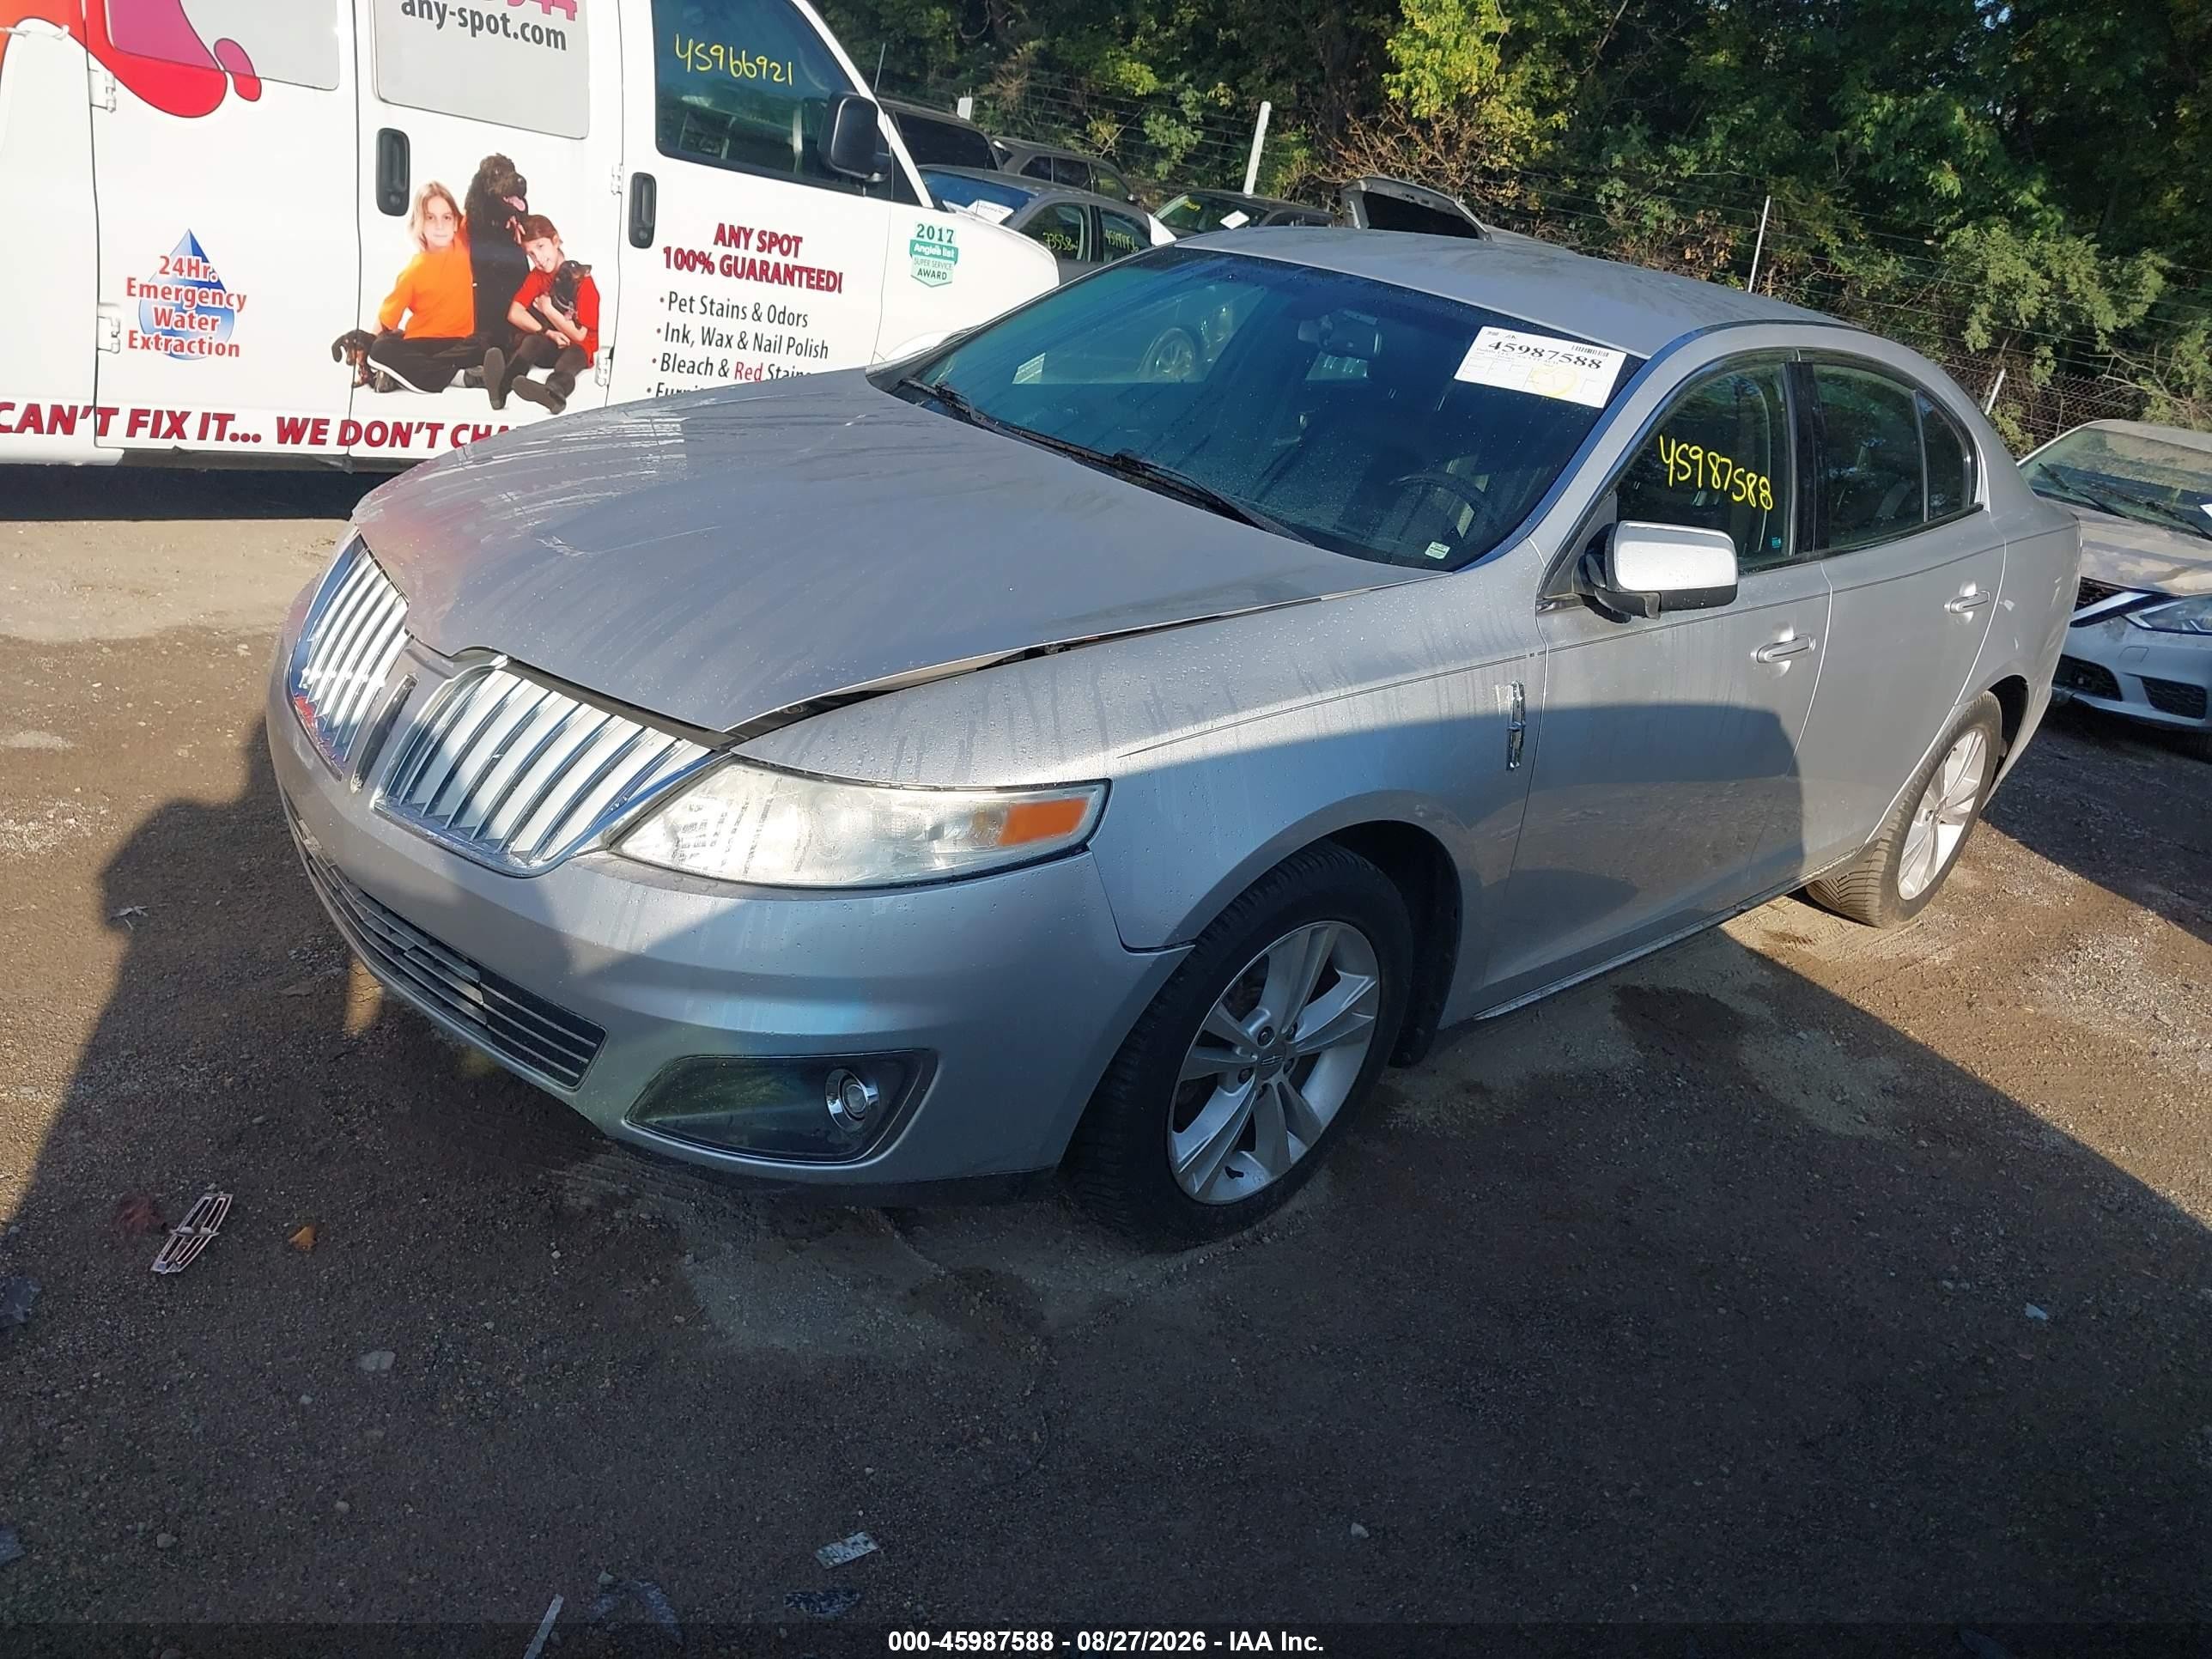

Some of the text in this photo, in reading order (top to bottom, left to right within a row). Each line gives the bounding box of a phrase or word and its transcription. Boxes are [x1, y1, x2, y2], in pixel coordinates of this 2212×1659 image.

[401, 0, 567, 51] any-spot.com
[675, 33, 793, 87] 45966921
[713, 222, 803, 258] ANY SPOT
[916, 223, 954, 244] 2017
[159, 256, 216, 281] 24Hr.
[663, 246, 844, 295] 100% GUARANTEED!
[917, 268, 947, 281] AWARD
[126, 276, 246, 313] Emergency
[668, 290, 808, 328] Pet Stains & Odors
[154, 307, 219, 331] Water
[128, 330, 240, 357] Extraction
[665, 322, 829, 360] Ink, Wax & Nail Polish
[1488, 341, 1603, 370] 45987588
[660, 352, 714, 377] Bleach
[718, 358, 730, 378] &
[734, 361, 763, 382] Red
[125, 408, 191, 440] FIX
[197, 411, 262, 443] IT...
[276, 416, 331, 446] WE
[337, 418, 445, 449] DON'T
[1659, 434, 1774, 510] 45987588
